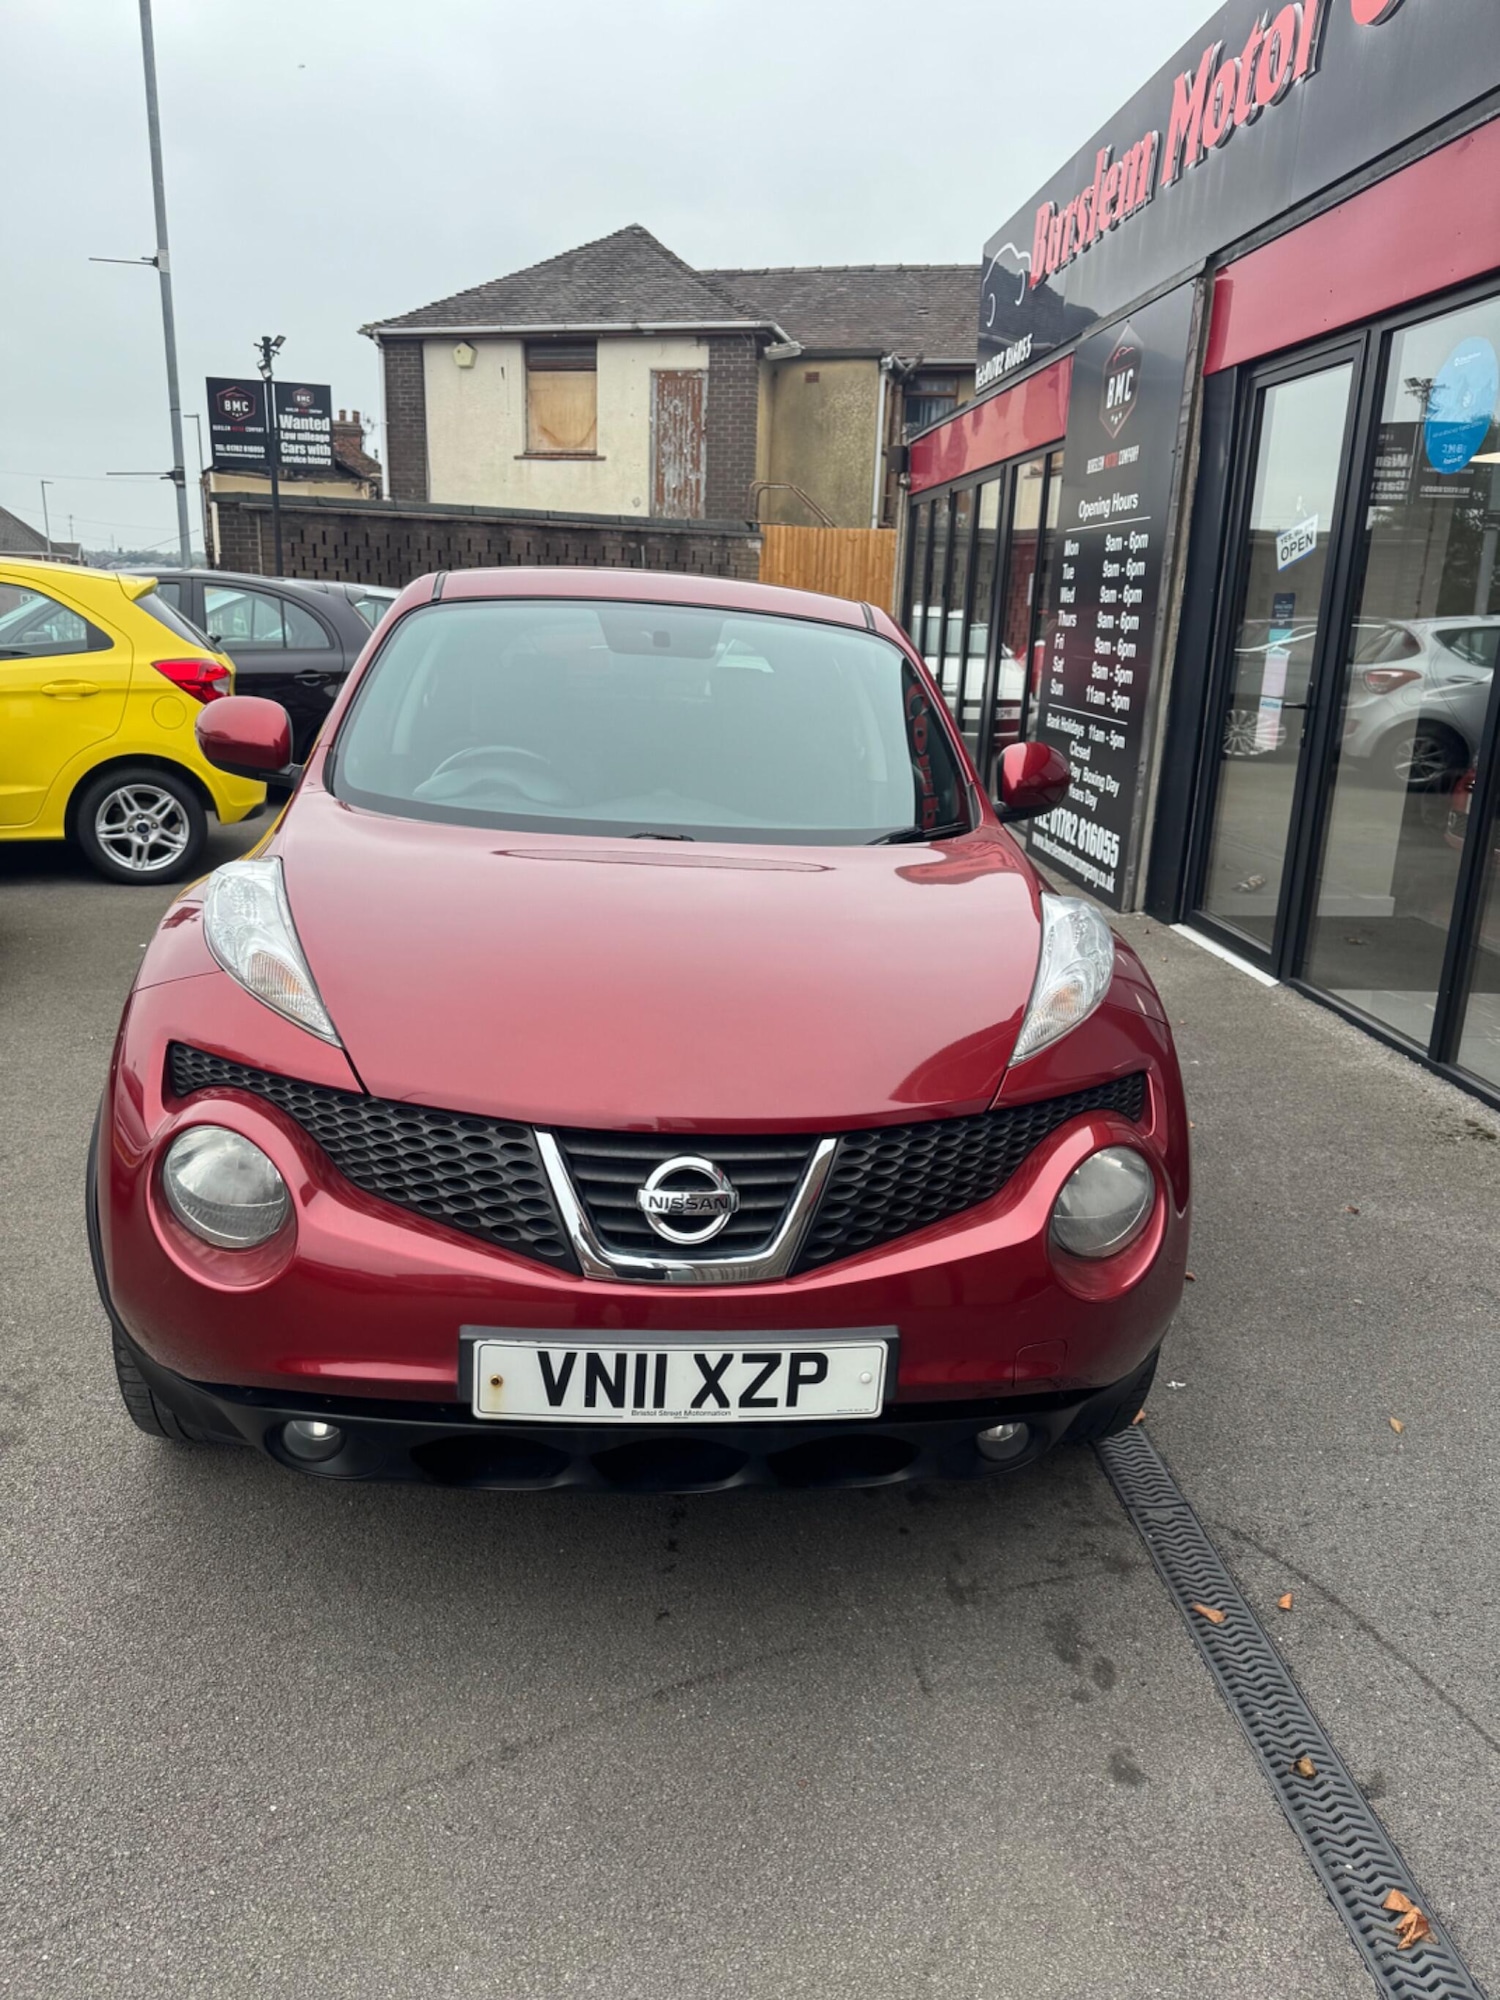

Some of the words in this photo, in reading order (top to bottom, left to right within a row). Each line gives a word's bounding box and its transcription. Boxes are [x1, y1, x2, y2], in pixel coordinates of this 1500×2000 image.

[1029, 132, 1156, 289] Burslem
[1161, 0, 1320, 188] Motor
[1106, 368, 1134, 409] BMC
[223, 399, 249, 412] BMC
[279, 414, 330, 431] Wanted
[280, 430, 296, 440] Low
[297, 432, 330, 443] mileage
[280, 442, 306, 455] Cars
[307, 444, 331, 456] with
[281, 455, 307, 464] service
[307, 456, 331, 466] history
[1078, 495, 1111, 522] Opening
[1111, 492, 1139, 513] Hours
[1064, 539, 1080, 557] Mon
[1105, 534, 1122, 552] 9am
[1129, 530, 1149, 554] 6pm
[1281, 530, 1314, 561] OPEN
[1062, 563, 1075, 580] Tue
[1102, 559, 1120, 578] 9am
[1126, 557, 1146, 581] 6pm
[1059, 586, 1076, 604] Wed
[1099, 585, 1117, 603] 9am
[1122, 584, 1143, 607] 6pm
[1057, 609, 1077, 628] Thurs
[1096, 610, 1114, 629] 9am
[1120, 611, 1140, 634] 6pm
[1054, 632, 1065, 650] Fri
[1094, 636, 1111, 655] 9am
[1117, 638, 1137, 661] 6pm
[1052, 655, 1064, 674] Sat
[1091, 661, 1108, 680] 9am
[1114, 664, 1134, 687] 5pm
[1050, 678, 1064, 696] Sun
[1085, 685, 1106, 706] 11am
[1110, 690, 1131, 713] 5pm
[1046, 712, 1060, 729] Bank
[1060, 716, 1085, 739] Holidays
[1088, 723, 1106, 743] 11am
[1109, 729, 1126, 750] 5pm
[1069, 740, 1091, 761] Closed
[1082, 766, 1106, 793] Boxing
[1105, 774, 1121, 798] Day
[1085, 789, 1099, 812] Day
[1050, 806, 1078, 847] 01782
[1077, 817, 1121, 869] 816055
[648, 1195, 729, 1211] NISSAN
[537, 1350, 668, 1409] VN11
[690, 1352, 829, 1409] XZP
